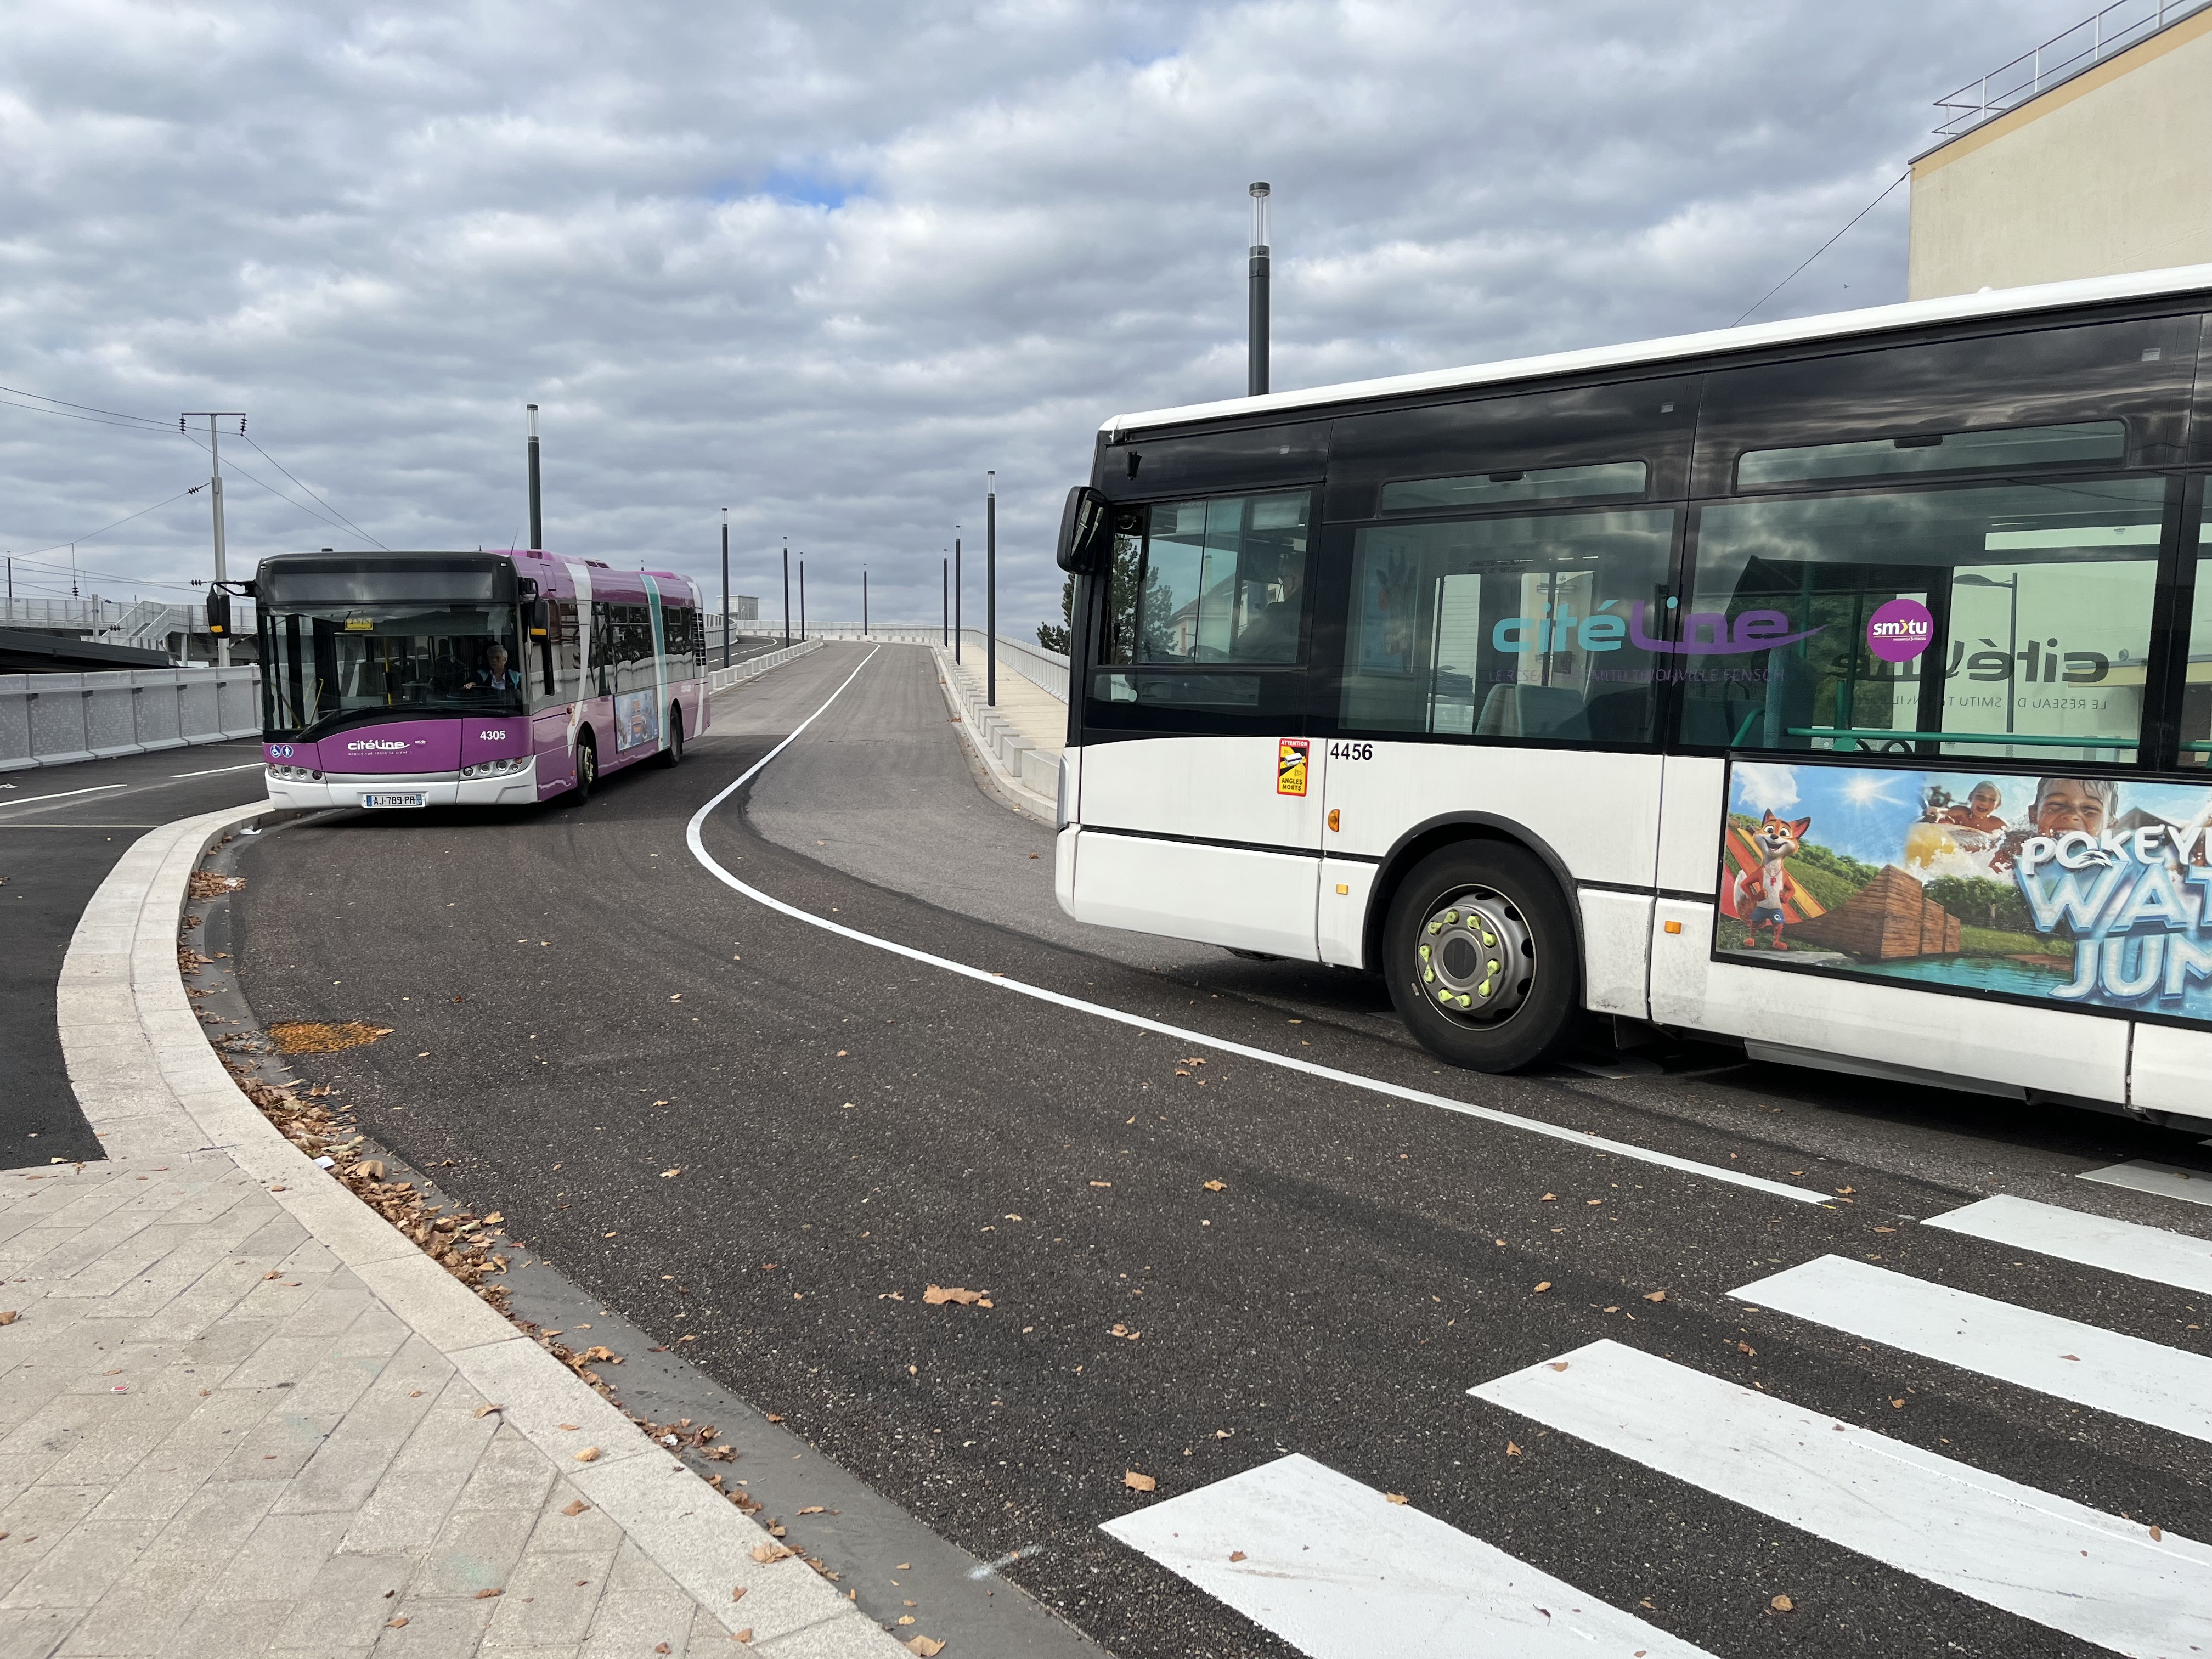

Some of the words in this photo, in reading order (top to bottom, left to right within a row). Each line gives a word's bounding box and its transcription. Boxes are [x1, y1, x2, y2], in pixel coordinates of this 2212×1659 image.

[1872, 619, 1927, 635] smitu
[479, 730, 506, 740] 4305
[1330, 742, 1373, 761] 4456
